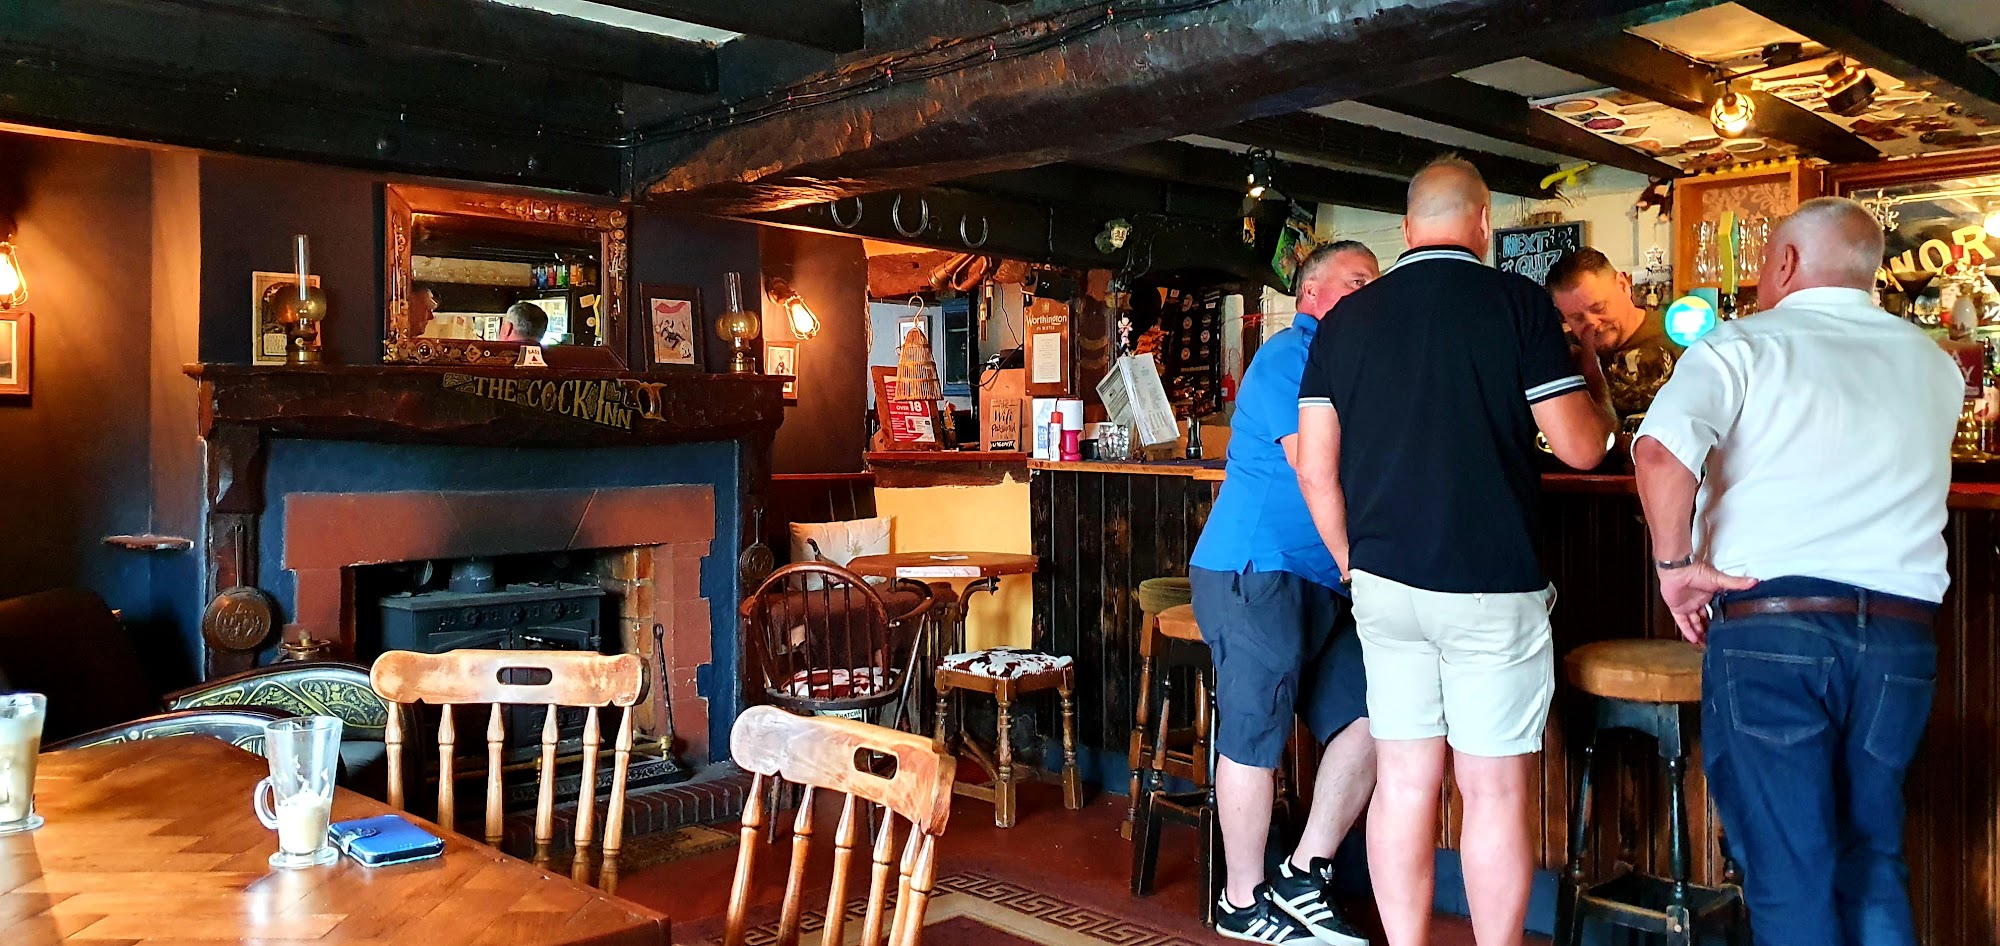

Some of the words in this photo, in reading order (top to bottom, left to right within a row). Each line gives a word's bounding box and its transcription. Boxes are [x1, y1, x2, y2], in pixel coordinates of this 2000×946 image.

[1503, 231, 1550, 258] NEXT
[1515, 249, 1563, 277] QUIZ
[1025, 315, 1067, 328] Worthington
[473, 376, 519, 403] THE
[527, 379, 592, 420] COCK
[595, 380, 633, 430] INN
[908, 400, 922, 412] 18
